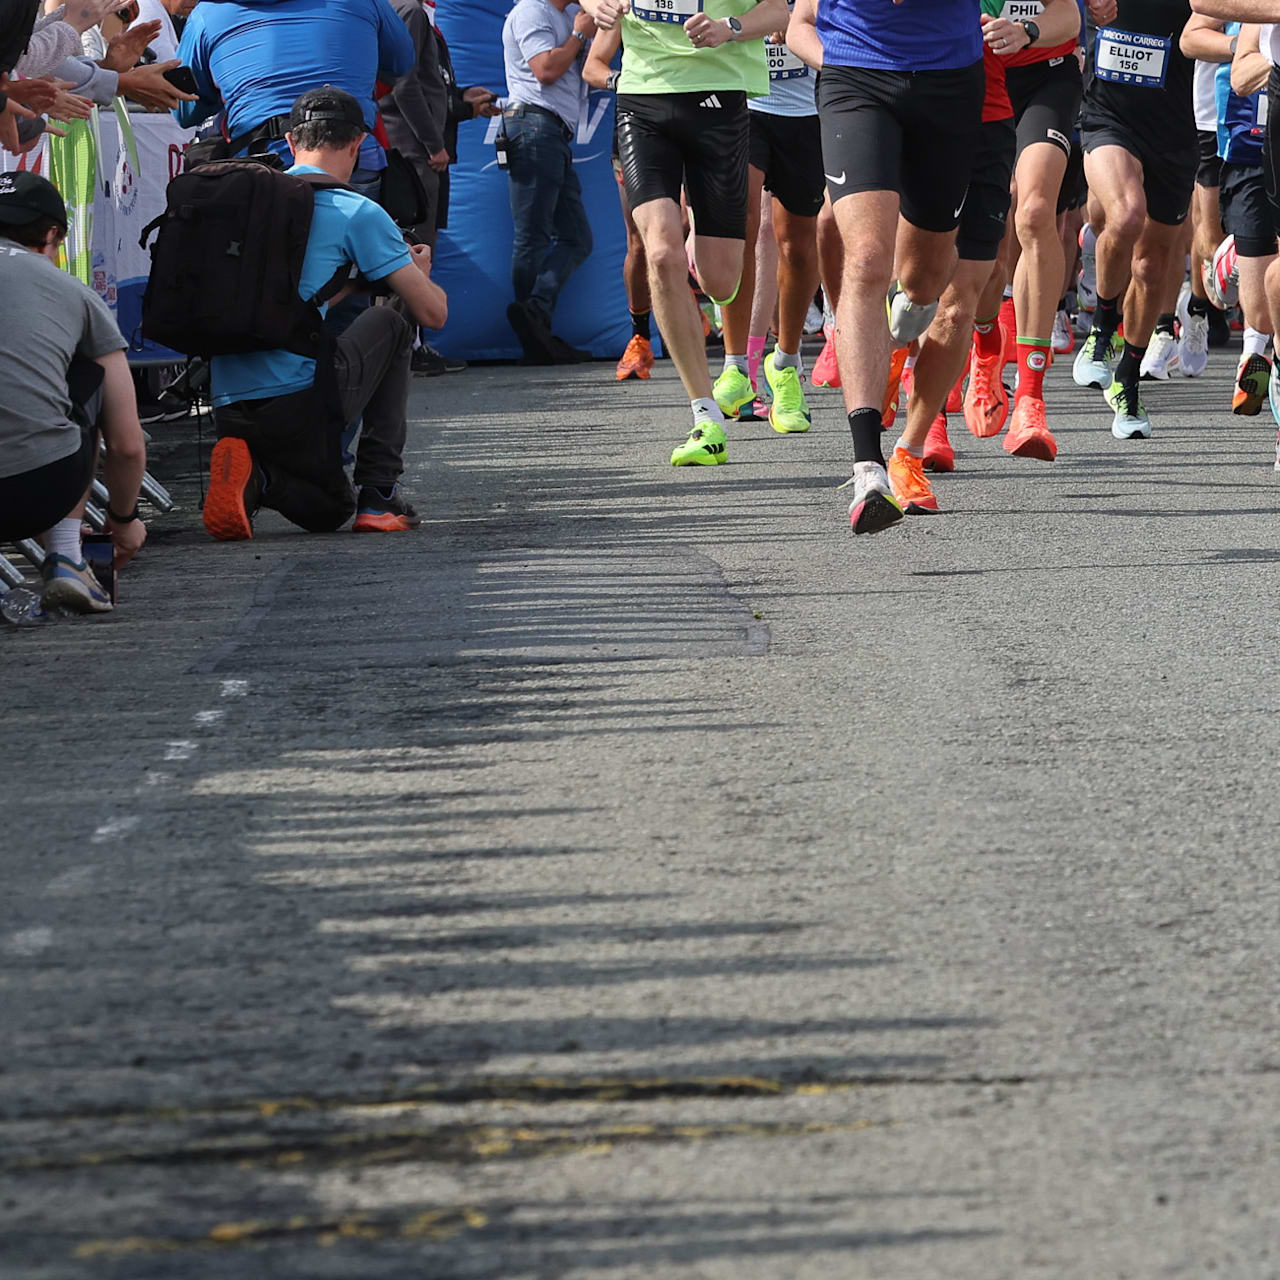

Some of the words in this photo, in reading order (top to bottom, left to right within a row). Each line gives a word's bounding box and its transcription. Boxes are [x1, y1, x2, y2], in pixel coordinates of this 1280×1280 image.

[655, 0, 674, 10] 138
[1009, 5, 1041, 16] PHIL
[1102, 29, 1132, 43] BRECON
[1132, 35, 1165, 48] CARREG
[1109, 46, 1153, 62] ELLIOT
[1119, 60, 1139, 71] 156
